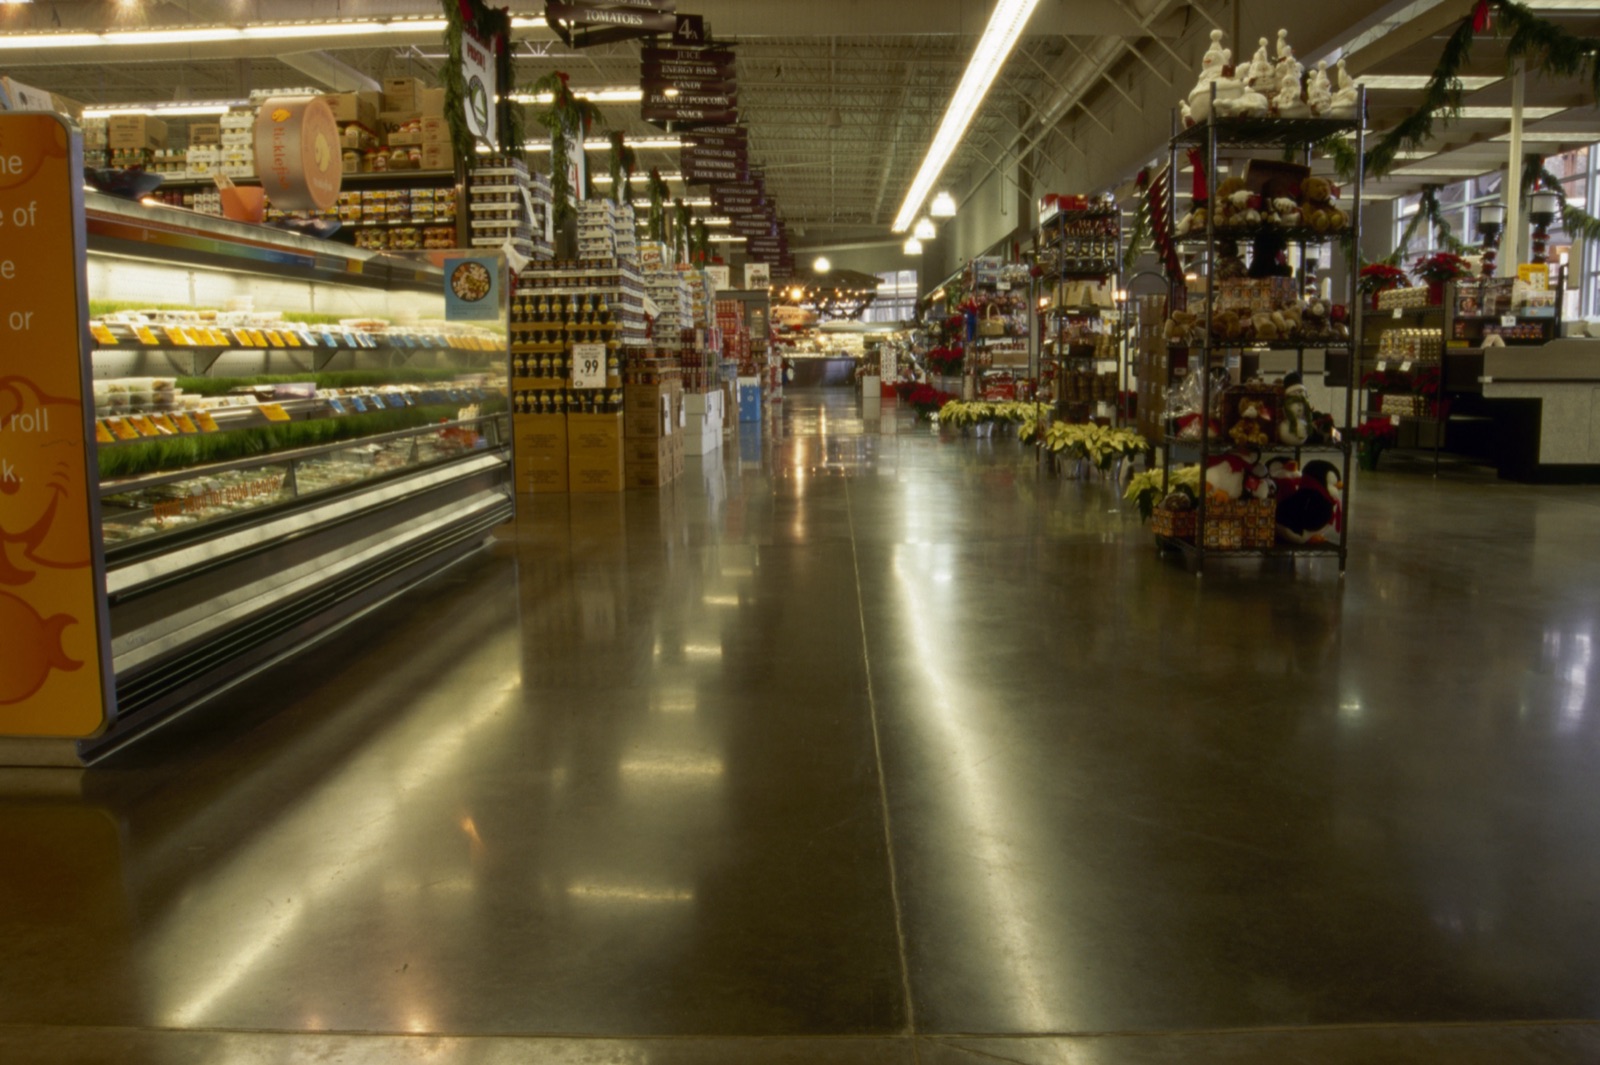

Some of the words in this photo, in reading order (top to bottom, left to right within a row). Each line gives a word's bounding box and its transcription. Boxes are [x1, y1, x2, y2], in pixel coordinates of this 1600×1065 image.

[585, 10, 643, 25] TOMATOES
[677, 50, 701, 60] JUICE
[662, 65, 694, 74] ENERGY
[696, 66, 718, 75] BARS
[673, 80, 702, 89] CANDY
[677, 109, 704, 119] SNACK
[693, 126, 715, 134] AKING
[704, 138, 725, 146] SPICES
[694, 149, 721, 157] COOKING
[13, 200, 37, 227] of
[9, 311, 33, 331] or
[11, 408, 48, 433] roll
[184, 494, 207, 513] food
[208, 490, 223, 507] for
[226, 481, 248, 508] good
